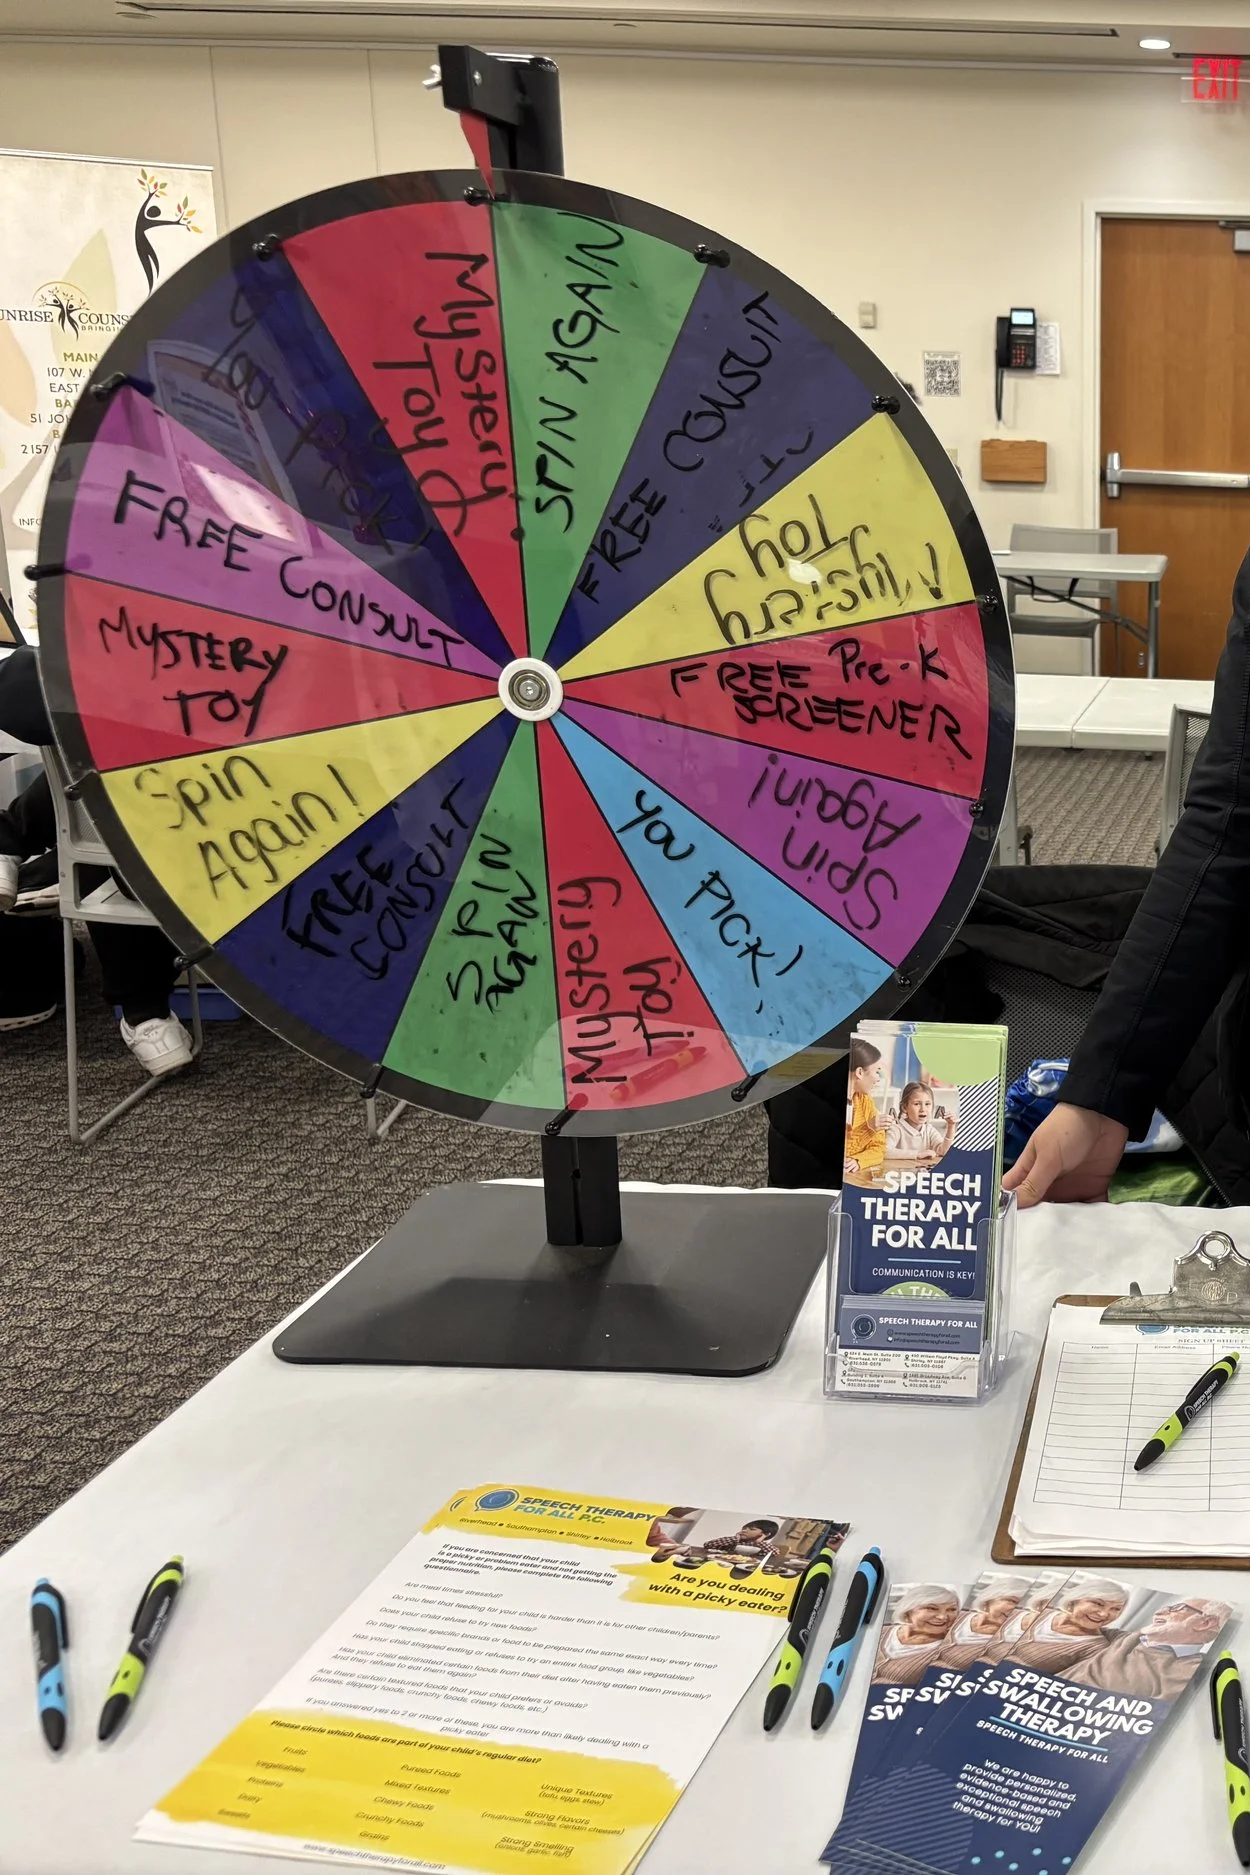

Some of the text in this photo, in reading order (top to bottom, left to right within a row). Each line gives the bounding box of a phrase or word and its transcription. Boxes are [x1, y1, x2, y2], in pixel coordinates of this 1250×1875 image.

[1193, 58, 1240, 101] EXIT
[47, 367, 64, 378] 107
[49, 383, 80, 393] EAST
[534, 211, 625, 536] SPIN AGAIN
[577, 478, 668, 604] FREE
[113, 470, 465, 668] FREE CONSULT
[99, 606, 289, 690] MYSTERY
[670, 660, 812, 698] FREE
[163, 684, 268, 737] TOY
[733, 693, 974, 760] SCREENER
[135, 755, 272, 830] Spin
[350, 777, 470, 980] CONSULT
[284, 846, 396, 959] FREE
[446, 832, 515, 1003] SPIN
[882, 1170, 982, 1197] SPEECH
[860, 1196, 982, 1224] THERAPY
[871, 1224, 978, 1251] FOR ALL
[872, 1268, 975, 1280] COMMUNICATION IS KEY!
[879, 1317, 978, 1329] SPEECH THERAPY FOR ALL
[513, 1504, 607, 1524] FOR ALL P.C.
[520, 1496, 657, 1522] SPEECH THERAPY
[648, 1583, 789, 1614] with a picky eater?
[669, 1573, 786, 1602] Are you dealing
[982, 1680, 1155, 1735] SWALLOWING
[1005, 1668, 1153, 1716] SPEECH AND
[975, 1719, 1110, 1764] SPEECH THERAPY FOR ALL
[999, 1703, 1112, 1746] THERAPY
[384, 1779, 451, 1795] Mixed Textures
[540, 1783, 613, 1799] Unique Textures
[524, 1810, 591, 1825] Strong Flavors
[952, 1801, 1042, 1834] therapy for YOU!
